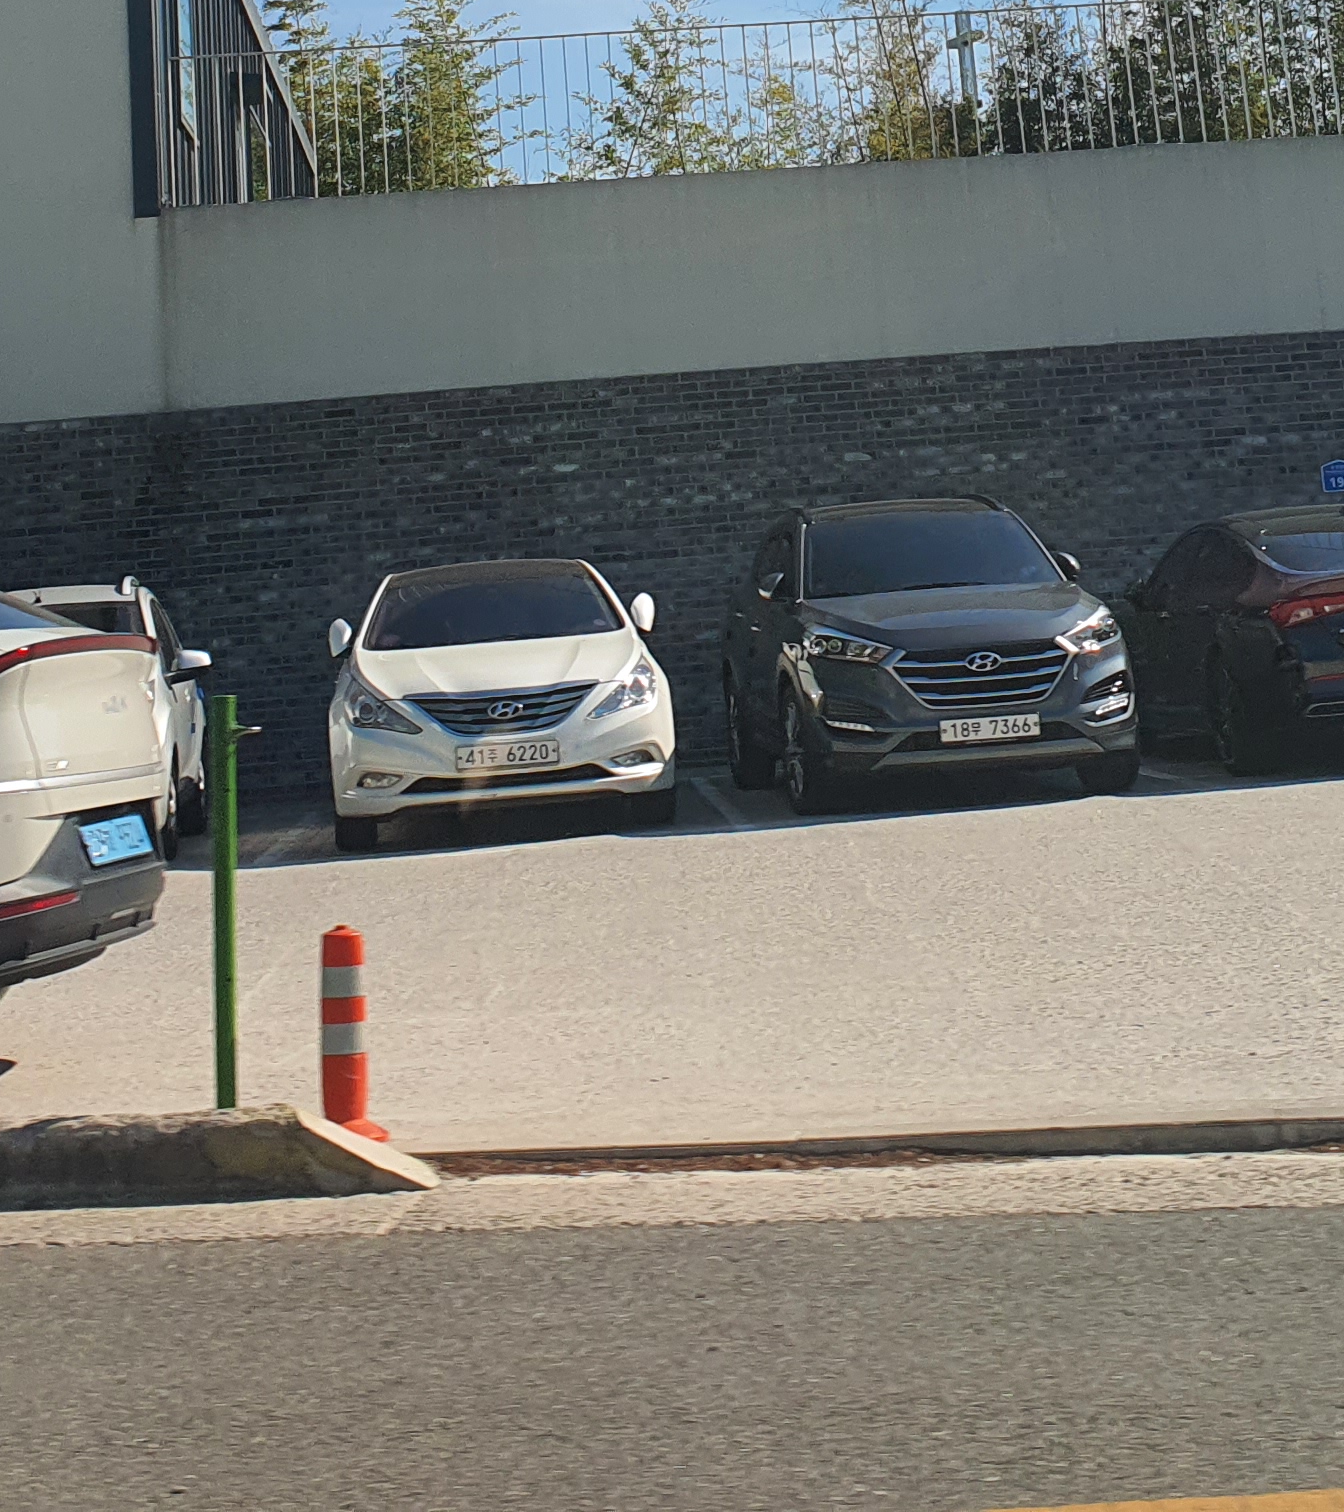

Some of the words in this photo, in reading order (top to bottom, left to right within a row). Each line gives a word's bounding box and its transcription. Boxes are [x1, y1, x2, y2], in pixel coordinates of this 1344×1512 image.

[950, 721, 982, 739] 18무
[988, 717, 1032, 736] 7366
[464, 748, 498, 766] 41주
[506, 743, 550, 763] 6220
